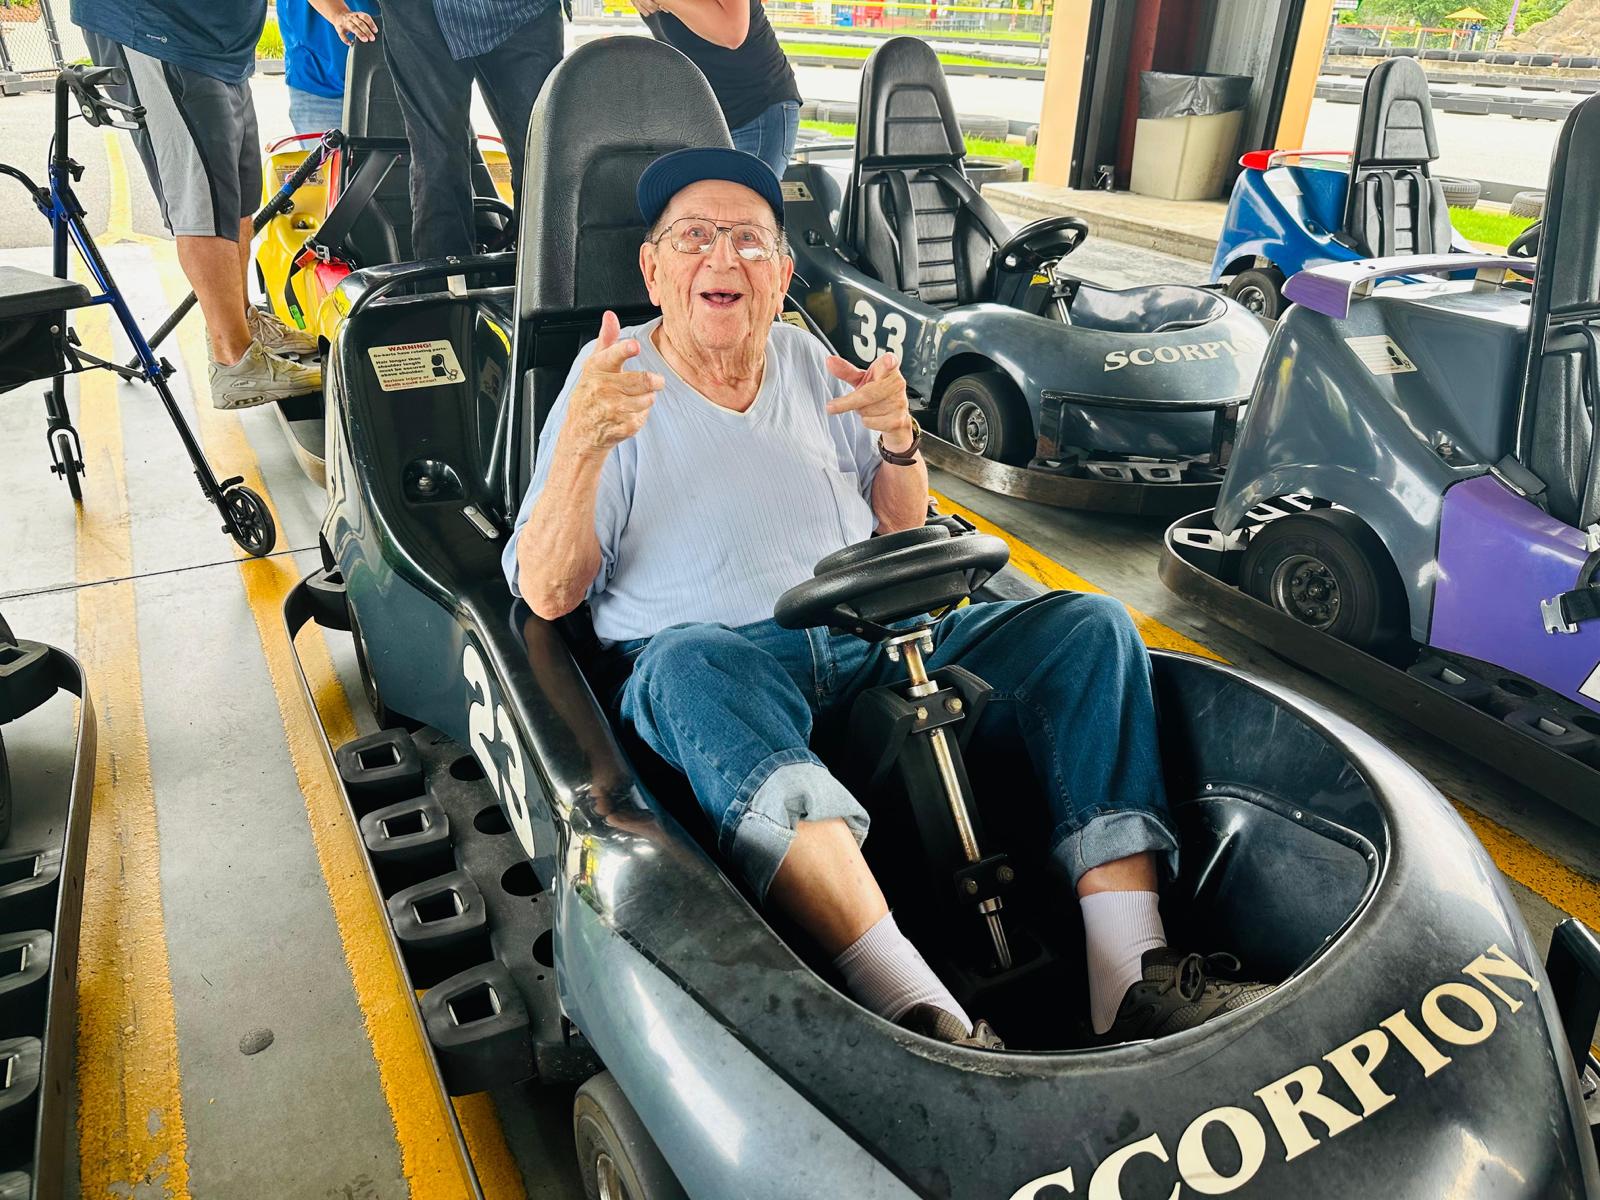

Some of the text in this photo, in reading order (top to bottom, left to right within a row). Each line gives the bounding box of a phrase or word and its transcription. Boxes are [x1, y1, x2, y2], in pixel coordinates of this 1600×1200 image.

[388, 343, 432, 351] WARNING!
[852, 299, 907, 368] 33
[1103, 339, 1241, 373] SCORPI
[462, 643, 536, 860] 23
